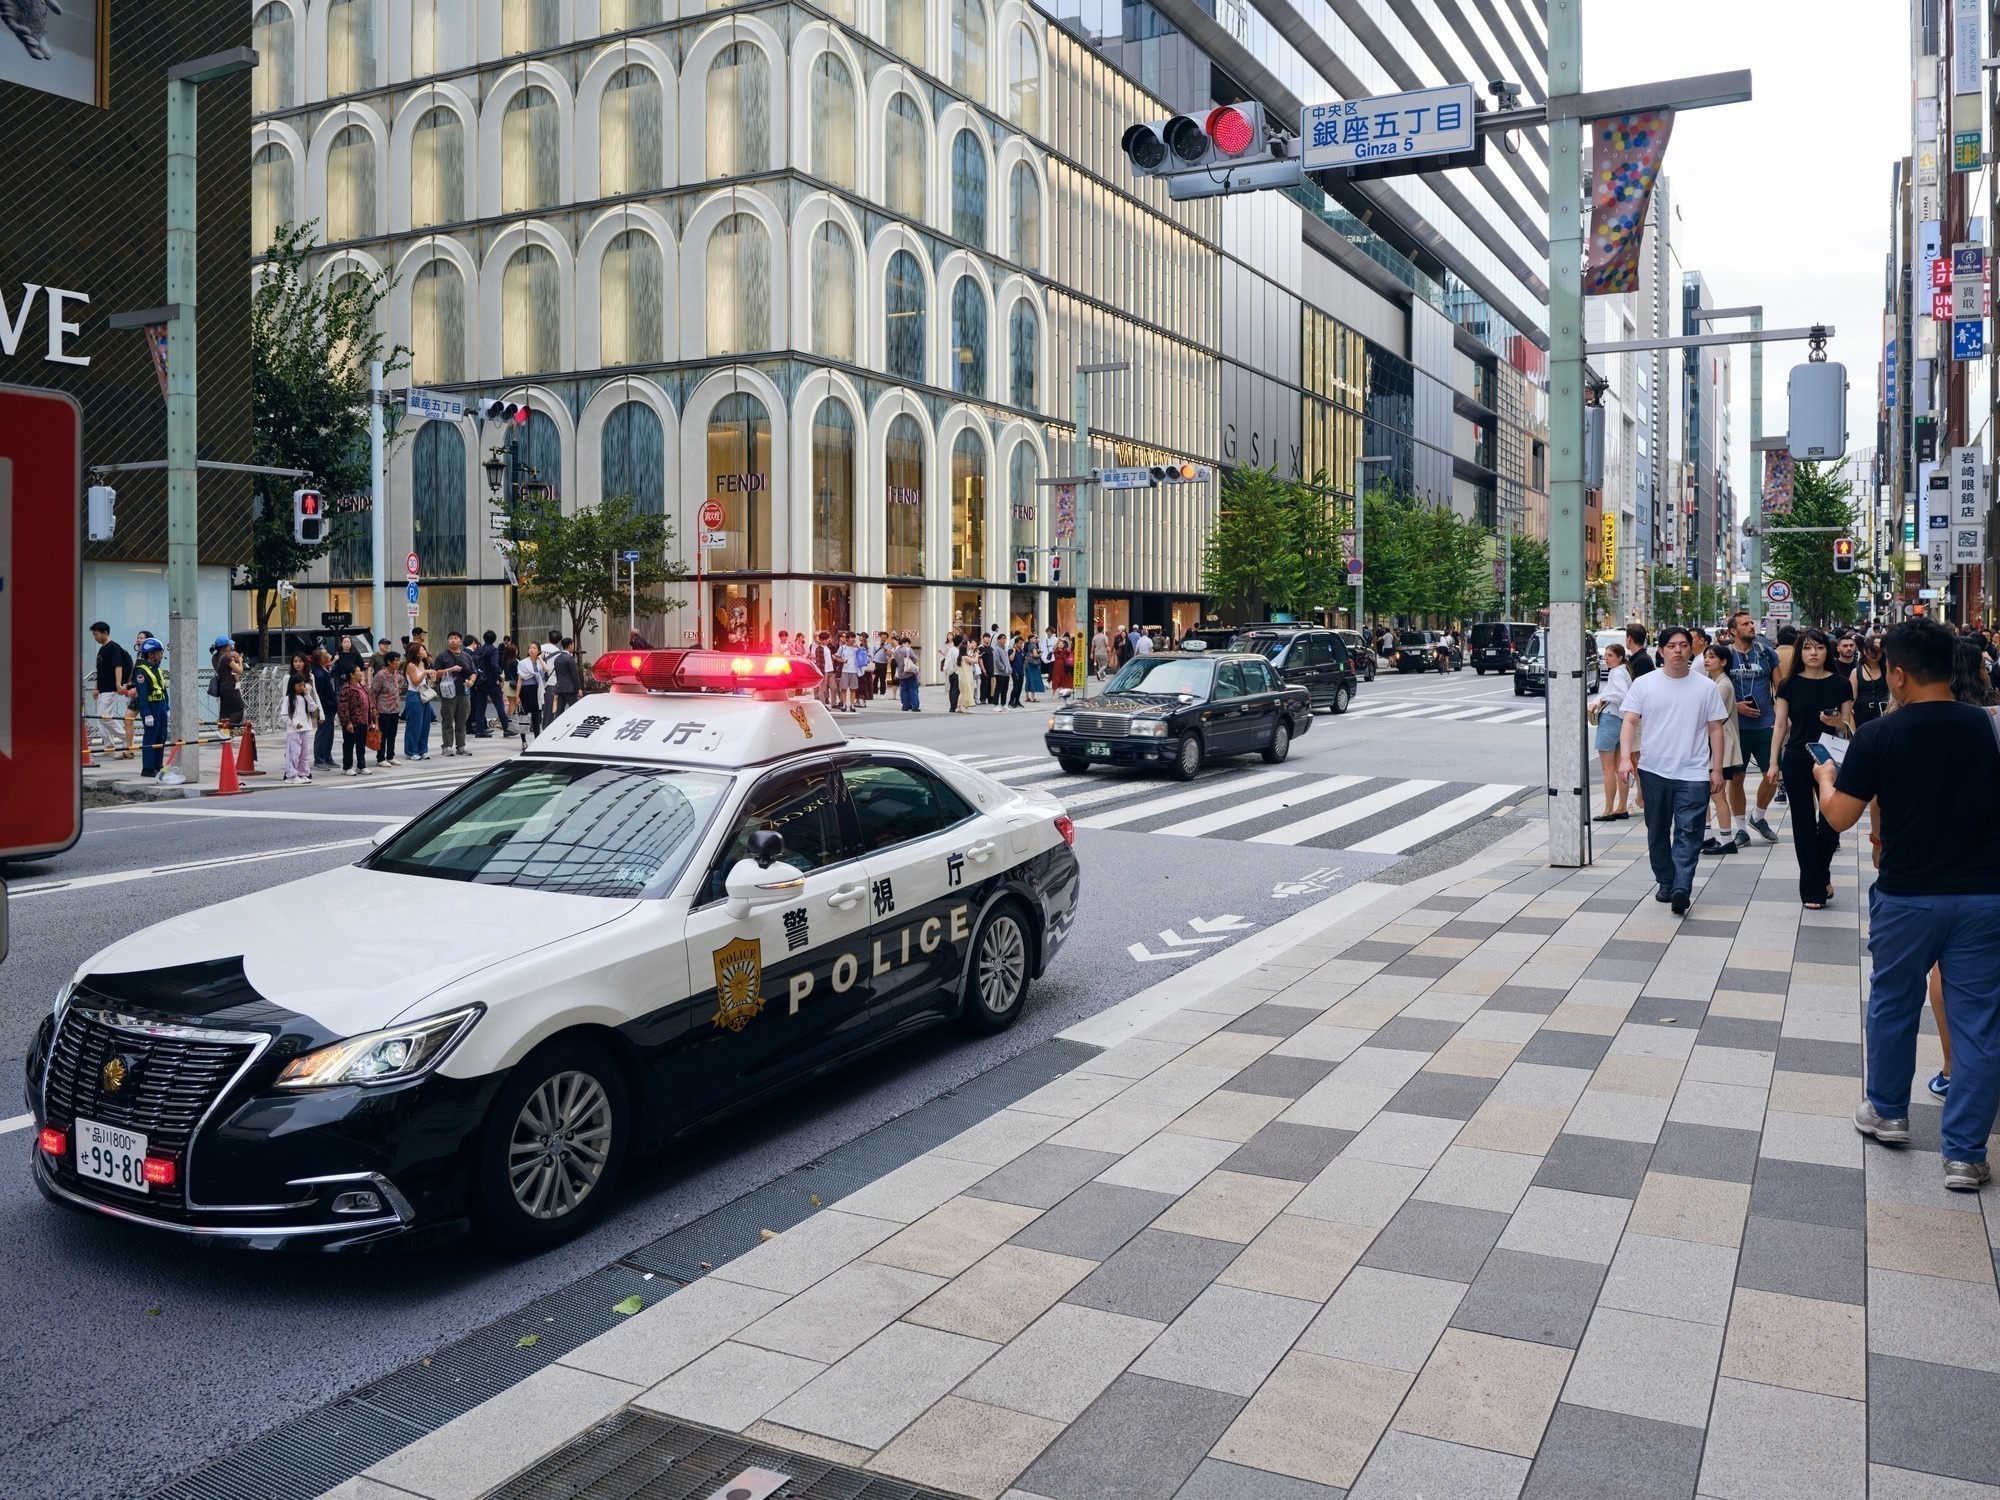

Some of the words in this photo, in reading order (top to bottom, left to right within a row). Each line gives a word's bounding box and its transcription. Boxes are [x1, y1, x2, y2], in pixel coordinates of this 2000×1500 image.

[1312, 102, 1358, 120] 中央区
[1312, 102, 1461, 148] 銀座五丁目
[1354, 142, 1397, 158] Ginza
[1403, 137, 1414, 151] 5
[1602, 139, 1662, 159] AUTUMN
[1936, 261, 1952, 272] ユ
[1935, 274, 1952, 284] ク
[1935, 295, 1952, 306] UN
[1962, 286, 1975, 309] 買取
[1935, 307, 1952, 318] QL
[1956, 328, 1981, 350] 青山
[411, 395, 461, 414] 銀座五丁目
[425, 409, 440, 418] Ginza
[716, 472, 766, 493] FENDI
[1103, 471, 1147, 483] 銀座五丁目
[1961, 452, 1975, 518] 岩崎眼鏡店
[888, 485, 919, 506] FENDI
[704, 510, 721, 522] 消火栓
[1605, 523, 1613, 576] ライオンビヤホール
[409, 558, 417, 569] 30
[1932, 553, 1943, 572] 菊水
[409, 587, 415, 602] P
[683, 630, 704, 639] FENI
[568, 714, 707, 745] 警視庁
[782, 852, 965, 952] 警視庁
[719, 947, 757, 969] POLICE
[788, 903, 970, 1017] POLICE
[80, 1150, 90, 1165] せ
[91, 1146, 144, 1187] 99-80
